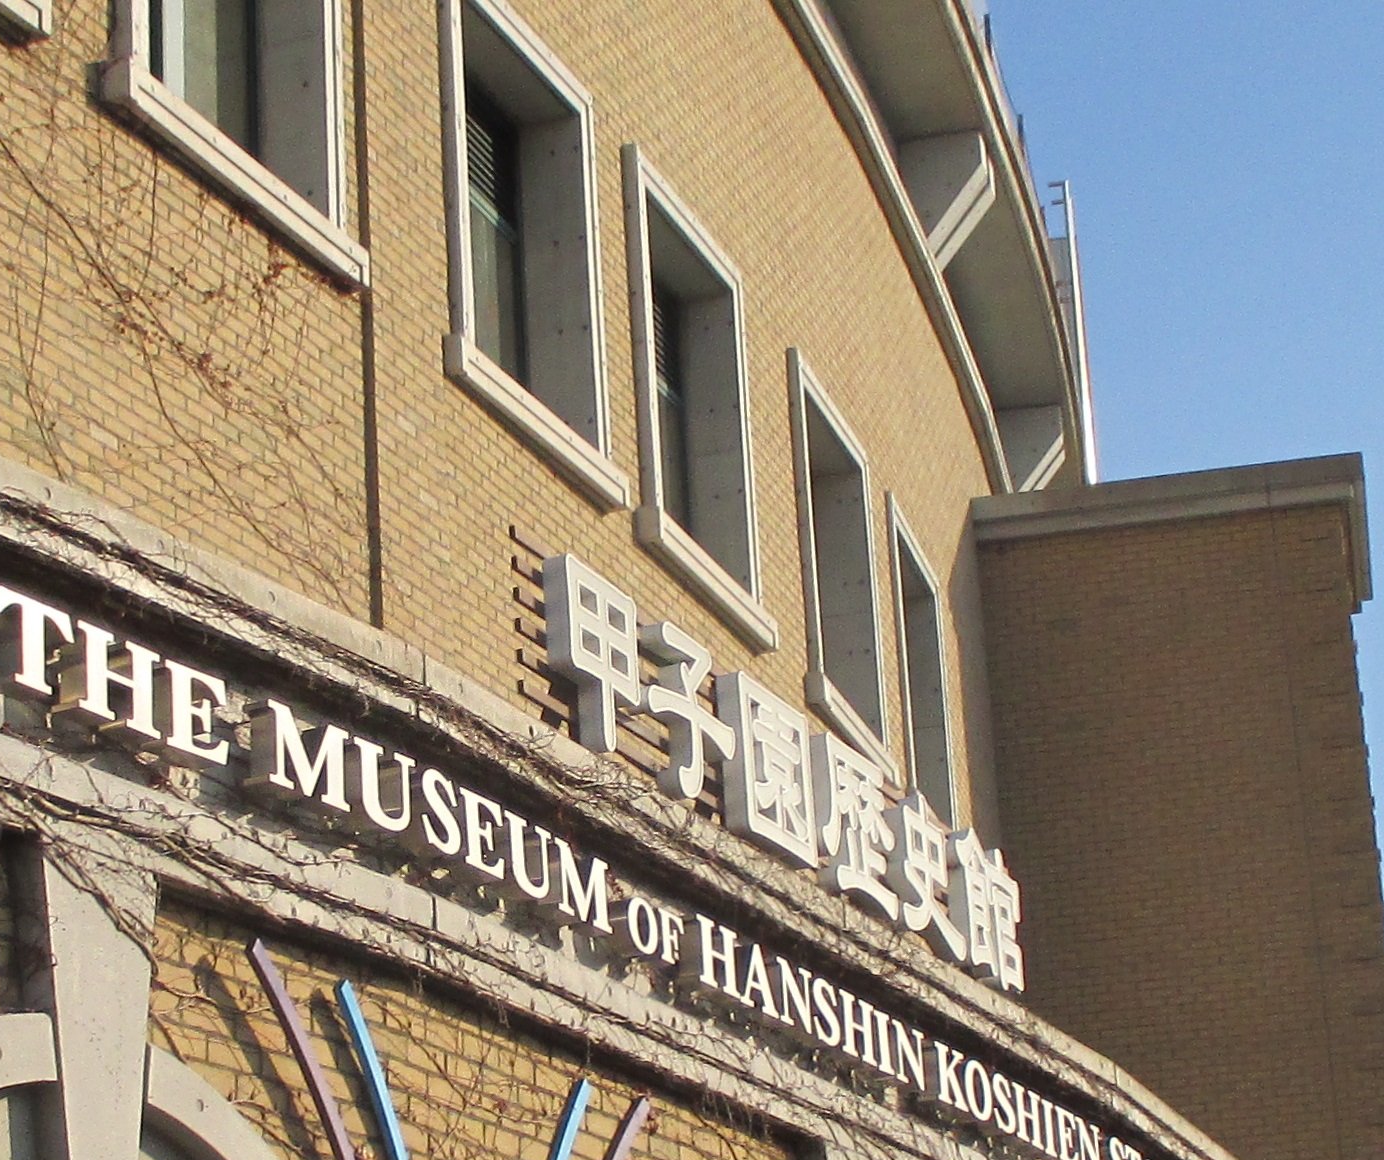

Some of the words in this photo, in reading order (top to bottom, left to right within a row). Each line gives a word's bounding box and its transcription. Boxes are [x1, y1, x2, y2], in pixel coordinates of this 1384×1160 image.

[266, 698, 614, 936] MUSEUM
[626, 896, 684, 966] OF
[696, 912, 926, 1091] HANSHIN
[561, 553, 1026, 993] 甲子園歴史館
